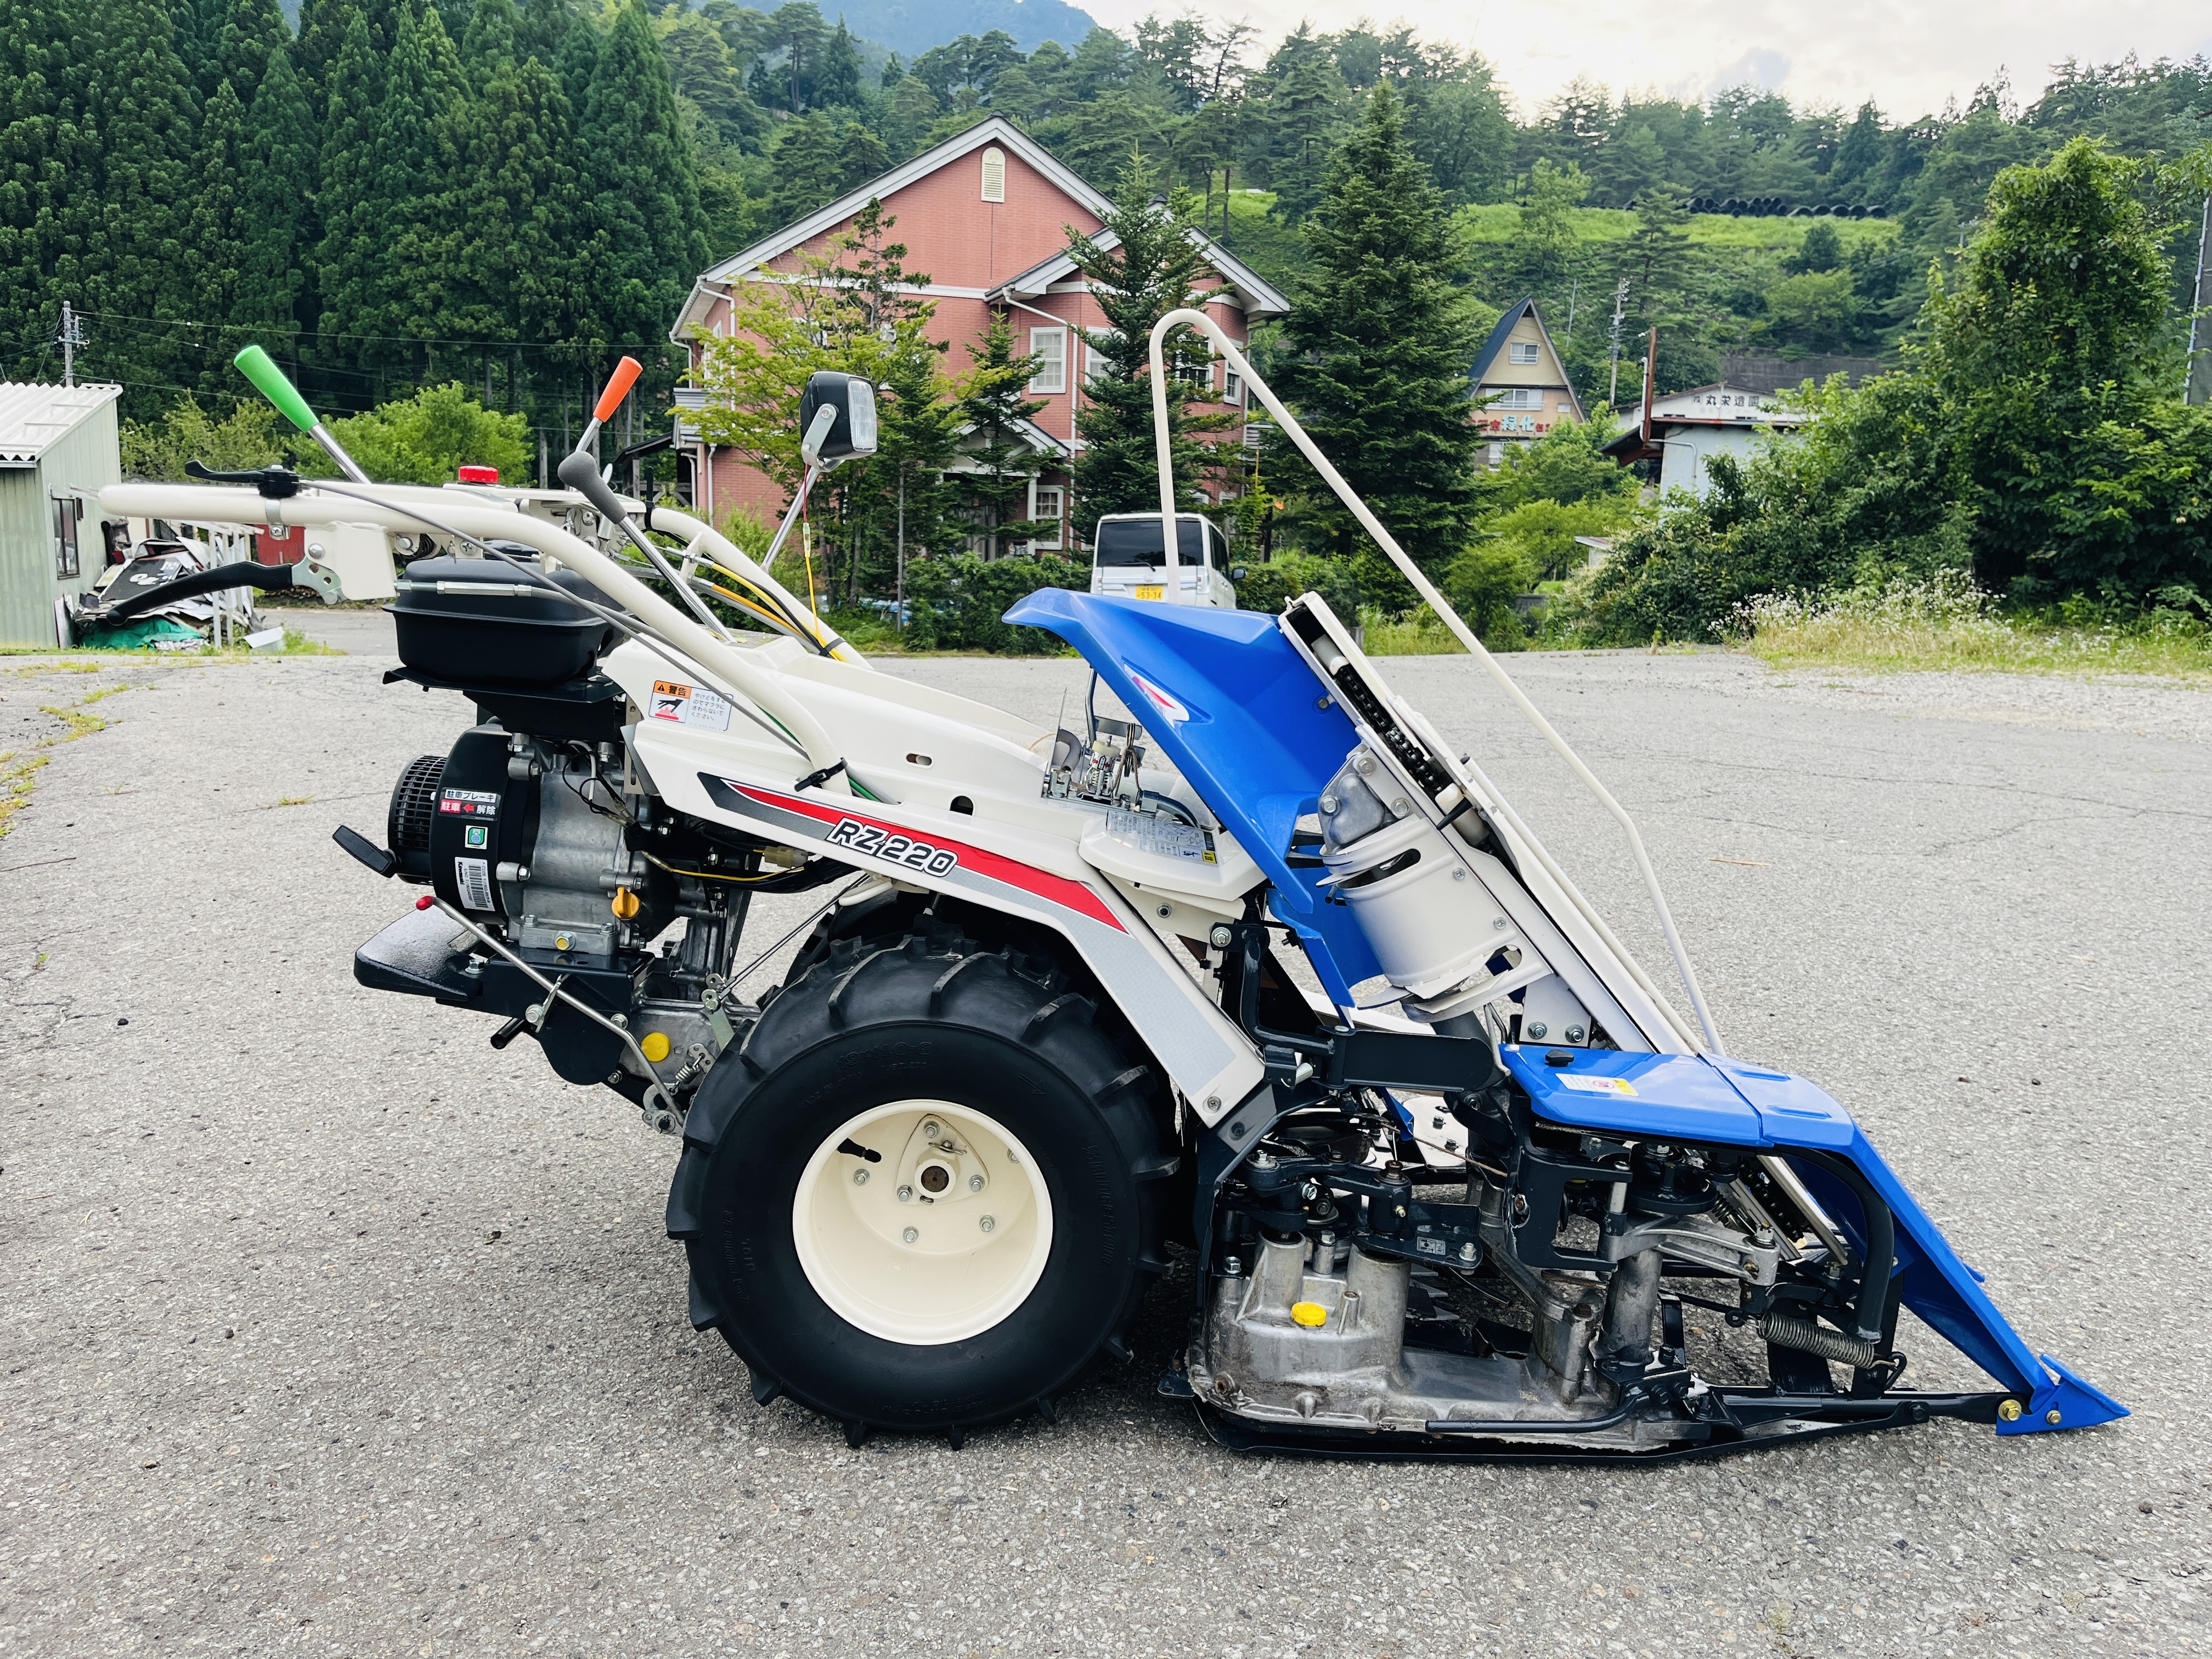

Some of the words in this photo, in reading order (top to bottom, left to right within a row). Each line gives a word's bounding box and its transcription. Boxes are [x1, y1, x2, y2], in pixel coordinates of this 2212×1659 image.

[669, 685, 687, 697] 警告
[693, 699, 725, 710] のでマフラに
[691, 712, 714, 721] ください。
[692, 706, 724, 716] さわらないで
[447, 791, 495, 802] 駐車ブレーキ
[441, 801, 461, 811] 駐車
[476, 805, 496, 815] 解除
[828, 818, 957, 876] RZ220
[1081, 1144, 1117, 1267] BRIDGESTONE
